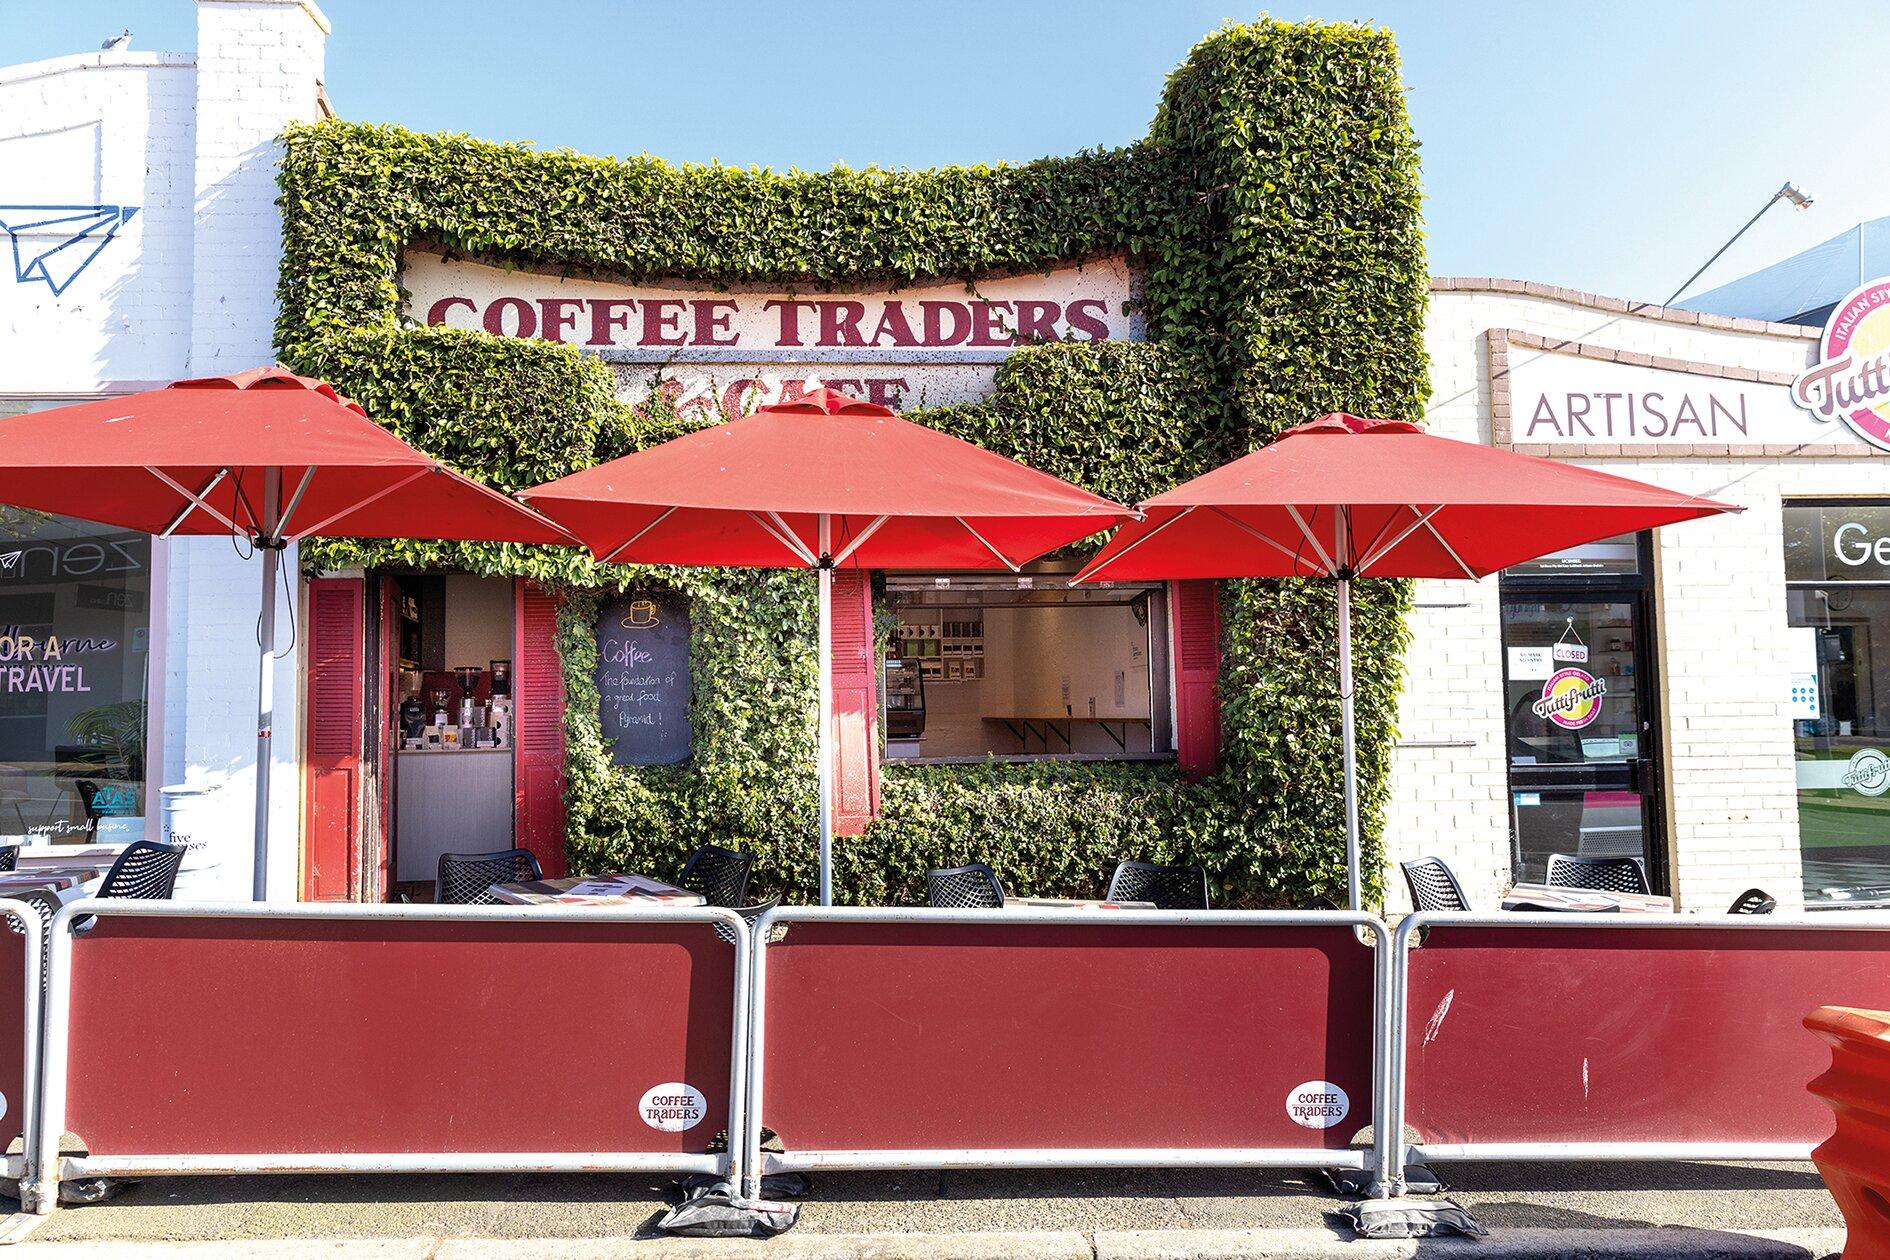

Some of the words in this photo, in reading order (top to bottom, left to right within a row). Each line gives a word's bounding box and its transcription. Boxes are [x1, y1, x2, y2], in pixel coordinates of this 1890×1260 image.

[427, 297, 741, 347] COFFEE
[763, 299, 1109, 347] TRADERS
[1835, 297, 1871, 341] ITALIAN
[1799, 352, 1890, 416] Tutt
[1527, 393, 1748, 437] ARTISAN
[43, 636, 61, 660] A
[603, 639, 653, 668] Coffee
[1556, 649, 1585, 660] CLOSED
[665, 671, 677, 687] of
[637, 690, 661, 706] food
[1535, 679, 1605, 717] Tuttifrutti
[27, 820, 68, 835] support
[67, 818, 93, 833] small
[170, 831, 191, 843] five
[652, 1096, 694, 1106] COFFEE
[1298, 1094, 1338, 1104] COFFEE
